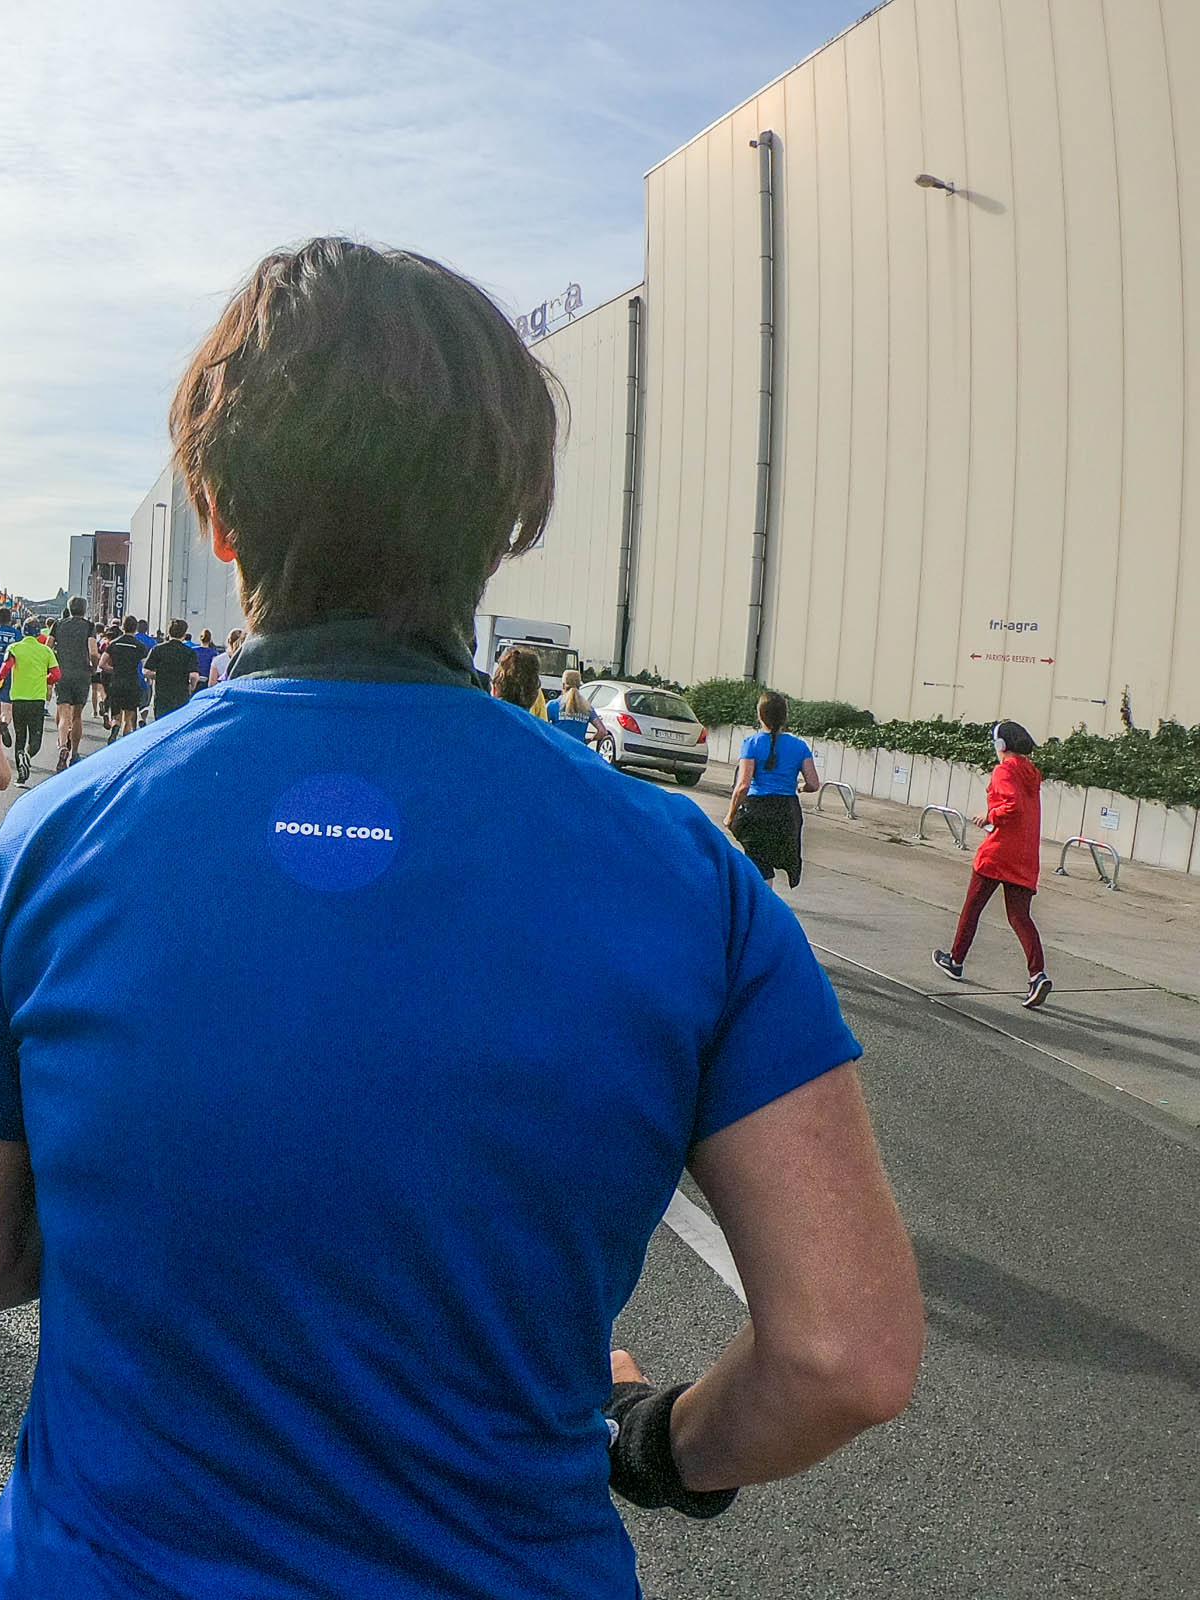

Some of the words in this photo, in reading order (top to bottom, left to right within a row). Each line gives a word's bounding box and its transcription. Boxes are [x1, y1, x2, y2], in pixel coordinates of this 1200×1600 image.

[989, 619, 1038, 633] fri-agra
[275, 821, 322, 836] POOL
[326, 825, 343, 837] IS
[346, 826, 393, 841] COOL
